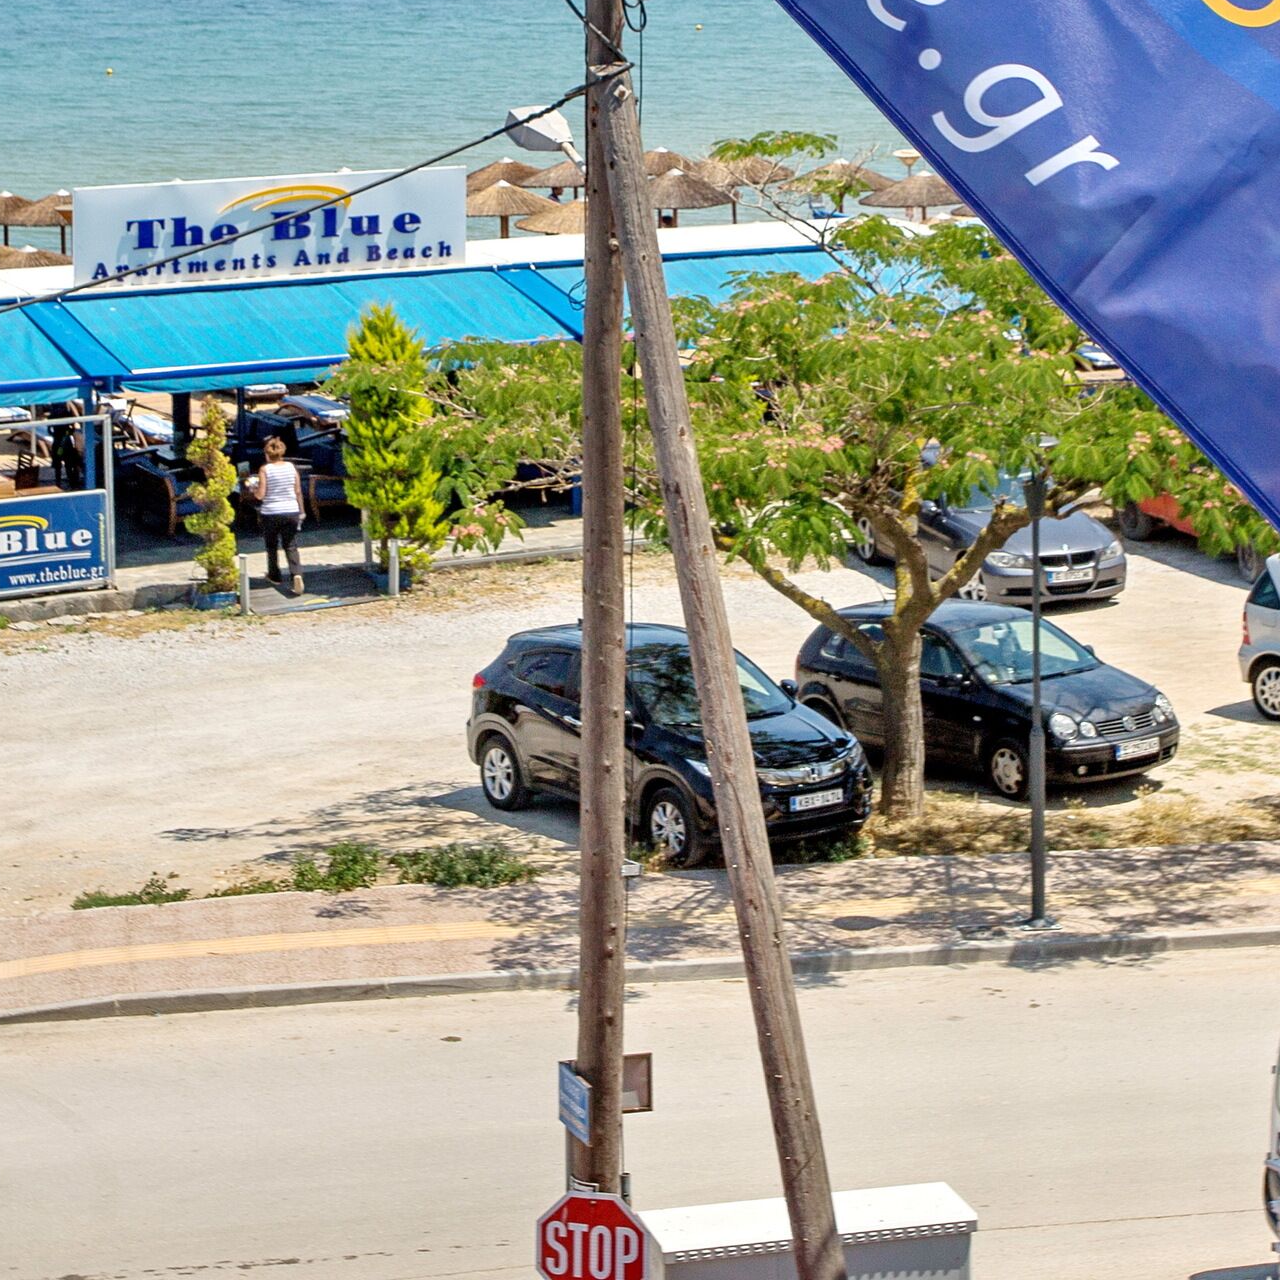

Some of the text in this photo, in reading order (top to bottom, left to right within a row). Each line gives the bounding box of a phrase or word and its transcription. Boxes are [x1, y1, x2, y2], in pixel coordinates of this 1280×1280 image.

[126, 207, 423, 250] The Blue
[293, 245, 350, 267] And
[365, 240, 454, 262] Beach
[8, 564, 105, 586] www.theblue.gr
[544, 1219, 640, 1280] STOP
